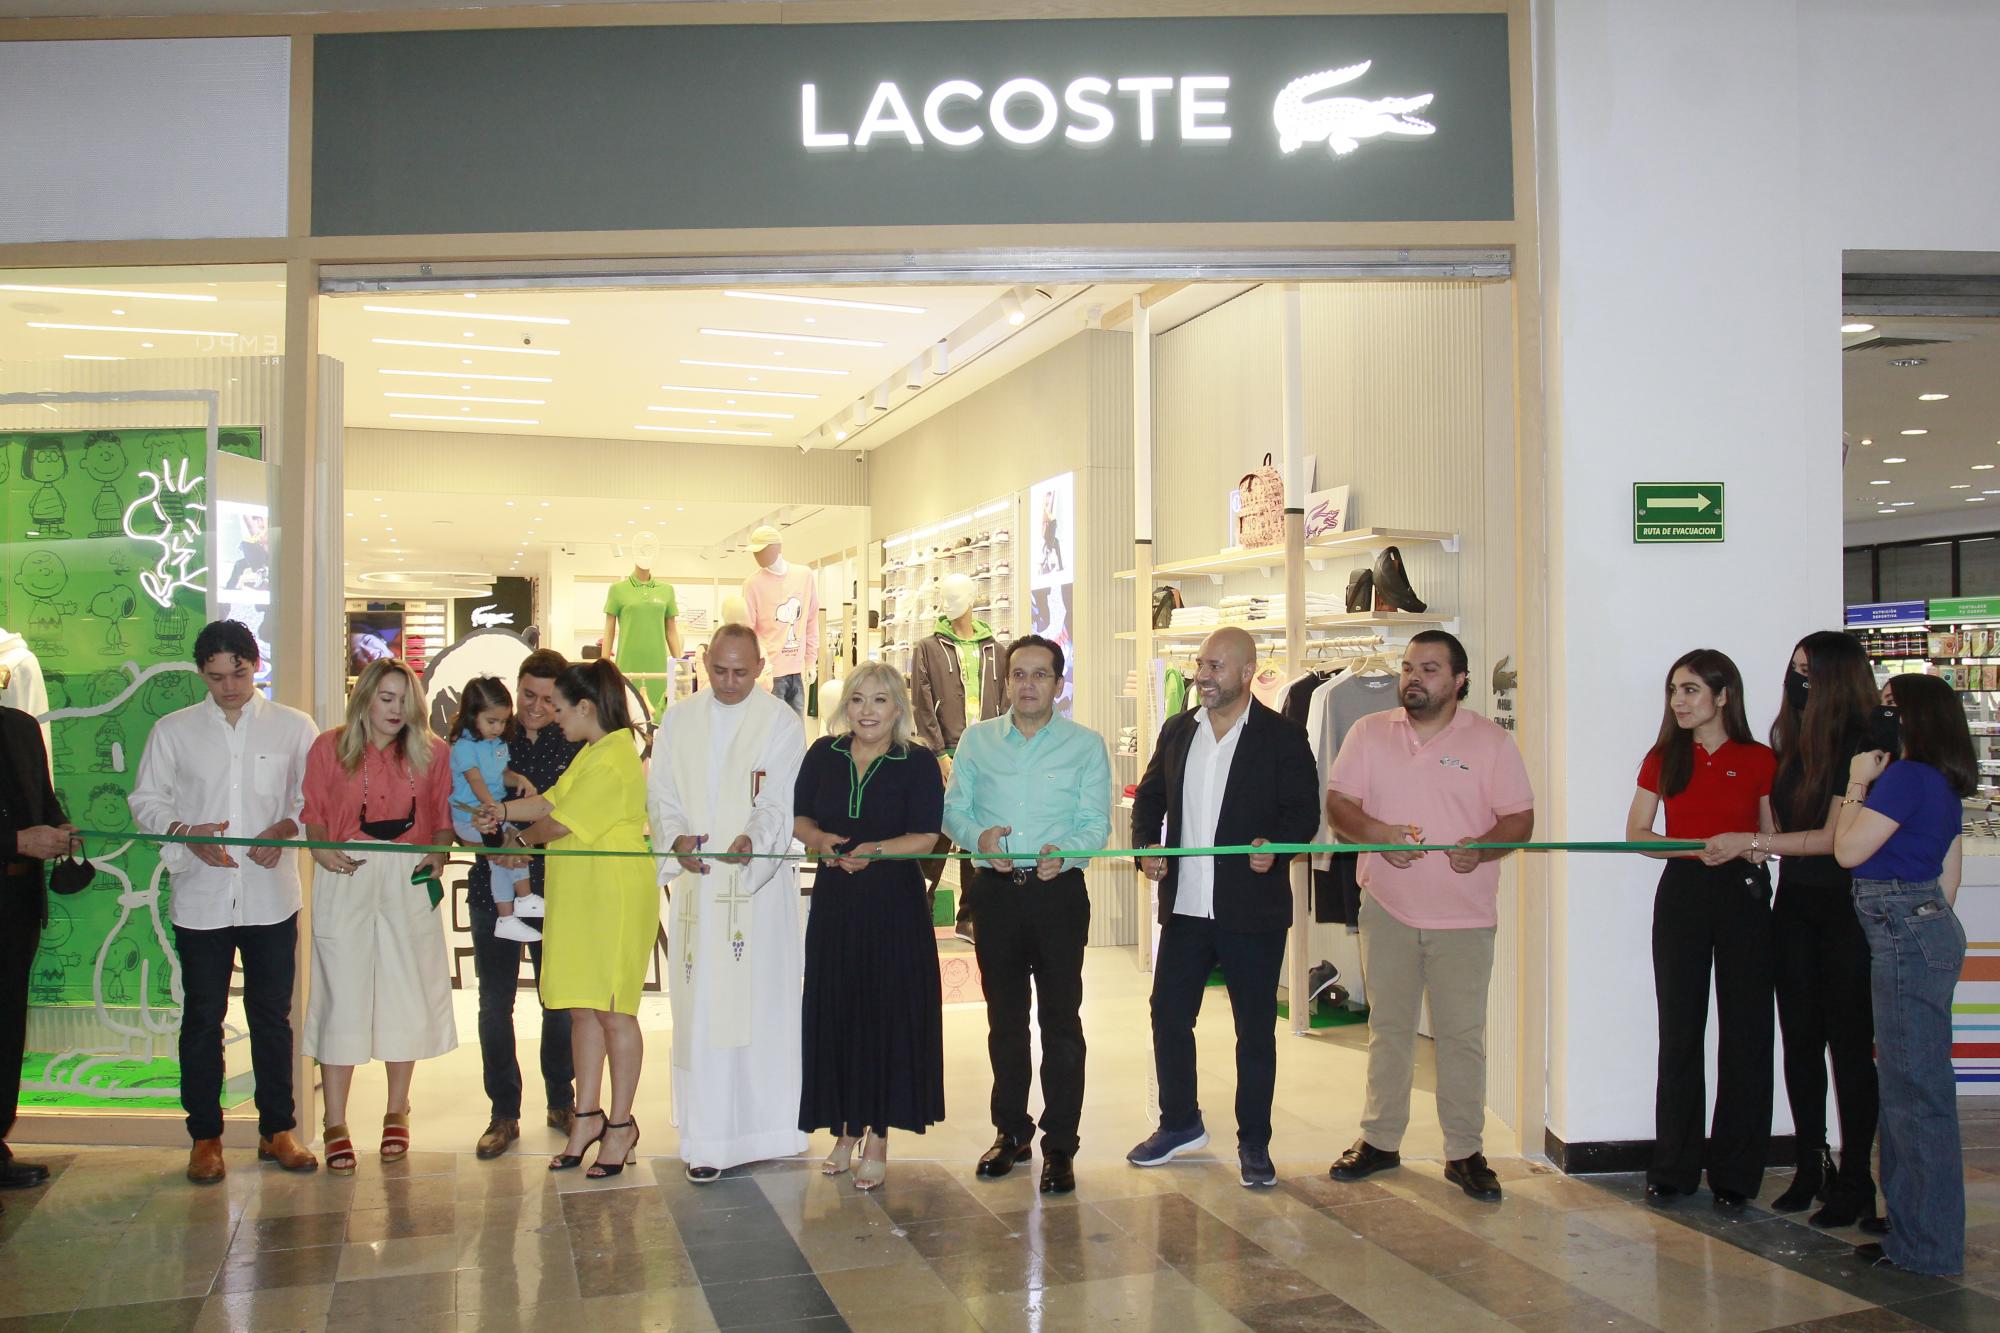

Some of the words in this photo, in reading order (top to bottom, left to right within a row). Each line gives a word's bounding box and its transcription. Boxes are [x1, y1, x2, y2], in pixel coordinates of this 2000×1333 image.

[802, 75, 1232, 146] LACOSTE
[1643, 527, 1661, 535] RUTA
[1662, 527, 1671, 535] DE
[1672, 527, 1716, 535] EVACUACION
